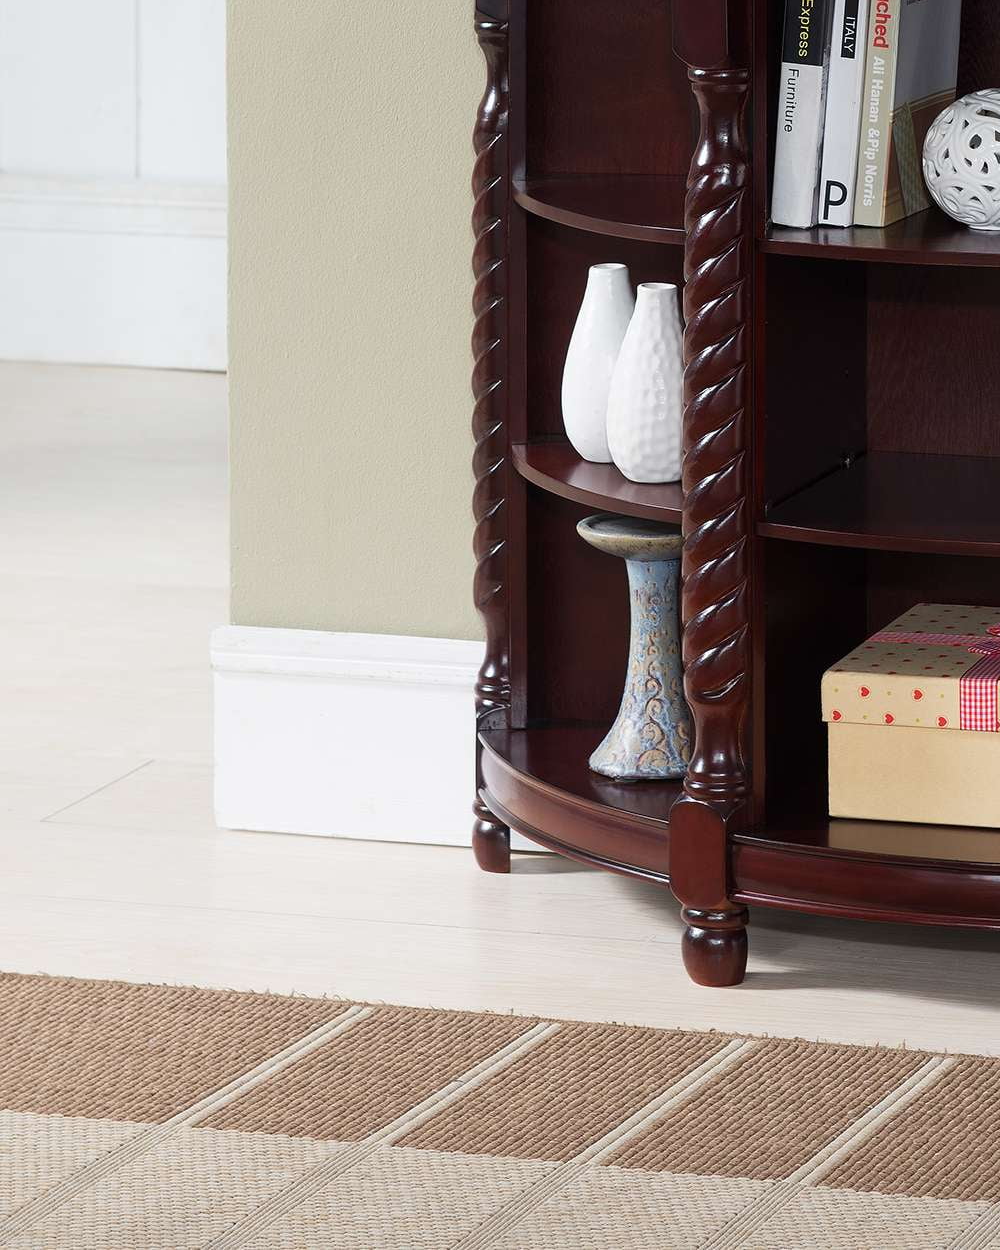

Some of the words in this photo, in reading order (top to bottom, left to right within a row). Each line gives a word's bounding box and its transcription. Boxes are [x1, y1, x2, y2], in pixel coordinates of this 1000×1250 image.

[844, 16, 856, 53] ITALY
[872, 56, 885, 75] Ali
[784, 68, 800, 133] Furniture
[868, 79, 884, 123] Hanan
[823, 180, 848, 220] P
[863, 165, 878, 207] Norris
